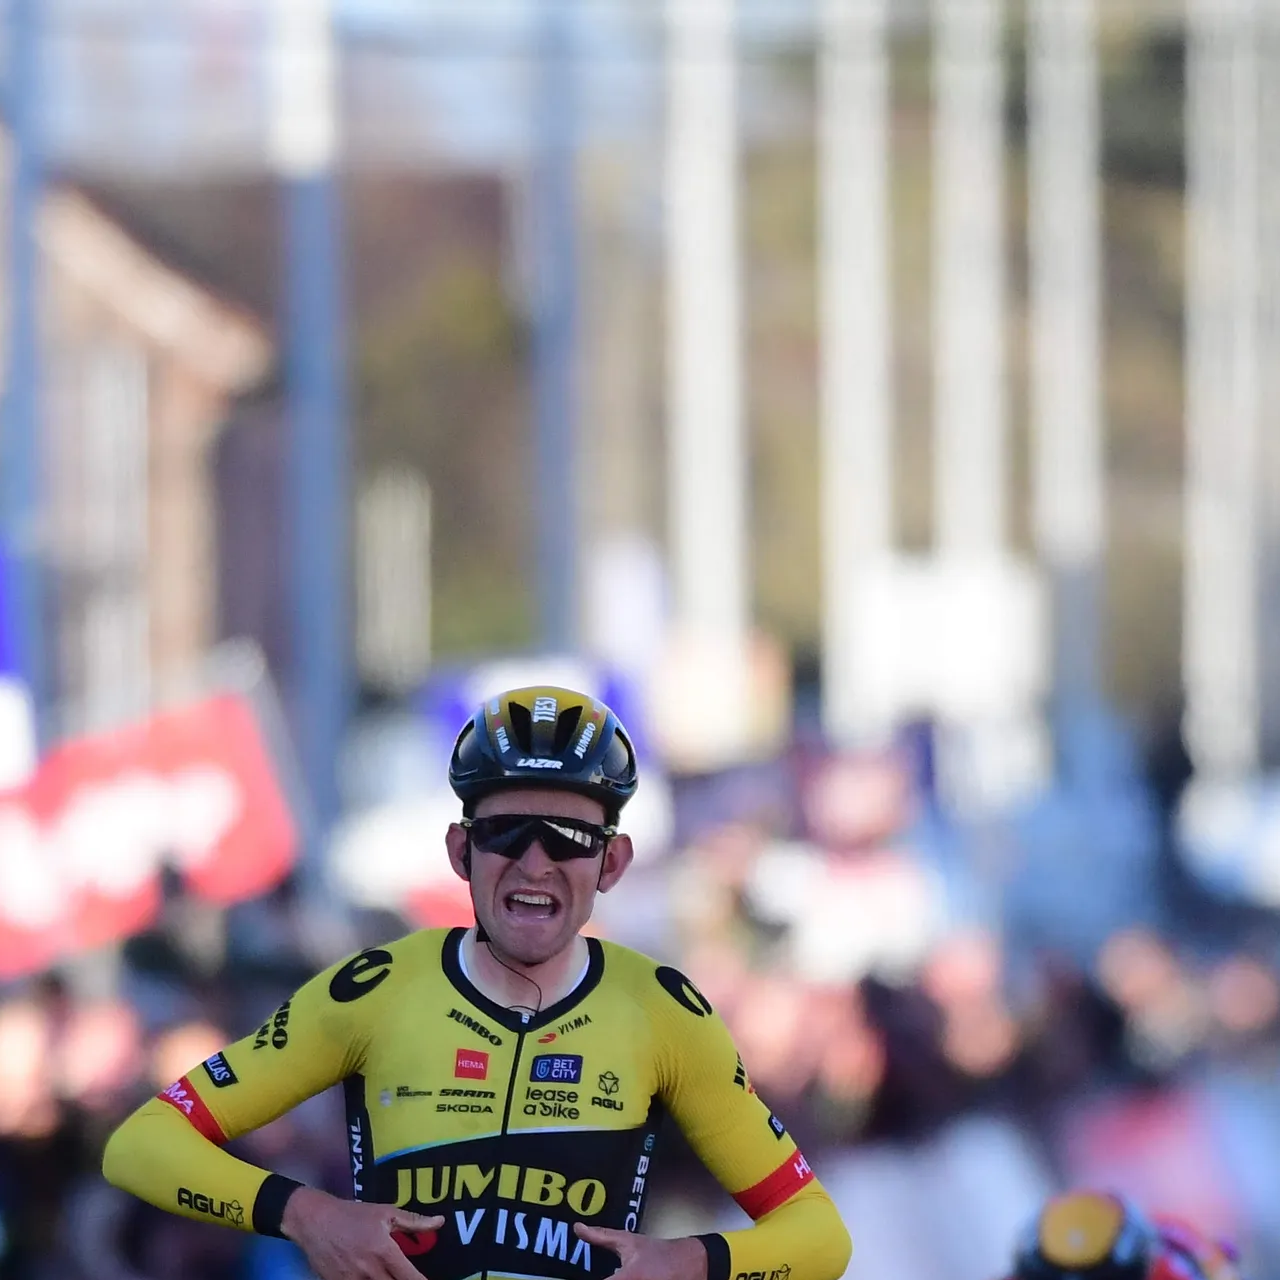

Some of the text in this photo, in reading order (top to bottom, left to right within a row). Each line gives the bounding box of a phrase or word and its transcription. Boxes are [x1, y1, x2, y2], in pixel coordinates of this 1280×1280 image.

[574, 722, 596, 760] JUMBO
[516, 758, 563, 770] LAZER
[446, 1008, 502, 1046] JUMBO
[558, 1014, 592, 1035] VISMA
[457, 1059, 484, 1070] HEMA
[553, 1058, 575, 1069] BET
[551, 1068, 577, 1079] CITY
[439, 1088, 497, 1099] SRAM
[525, 1086, 579, 1103] lease
[435, 1104, 493, 1114] SKODA
[539, 1102, 580, 1120] bike
[591, 1096, 624, 1111] AGU
[393, 1163, 606, 1217] JUMBO
[177, 1187, 225, 1218] AGU
[455, 1208, 591, 1273] VISMA
